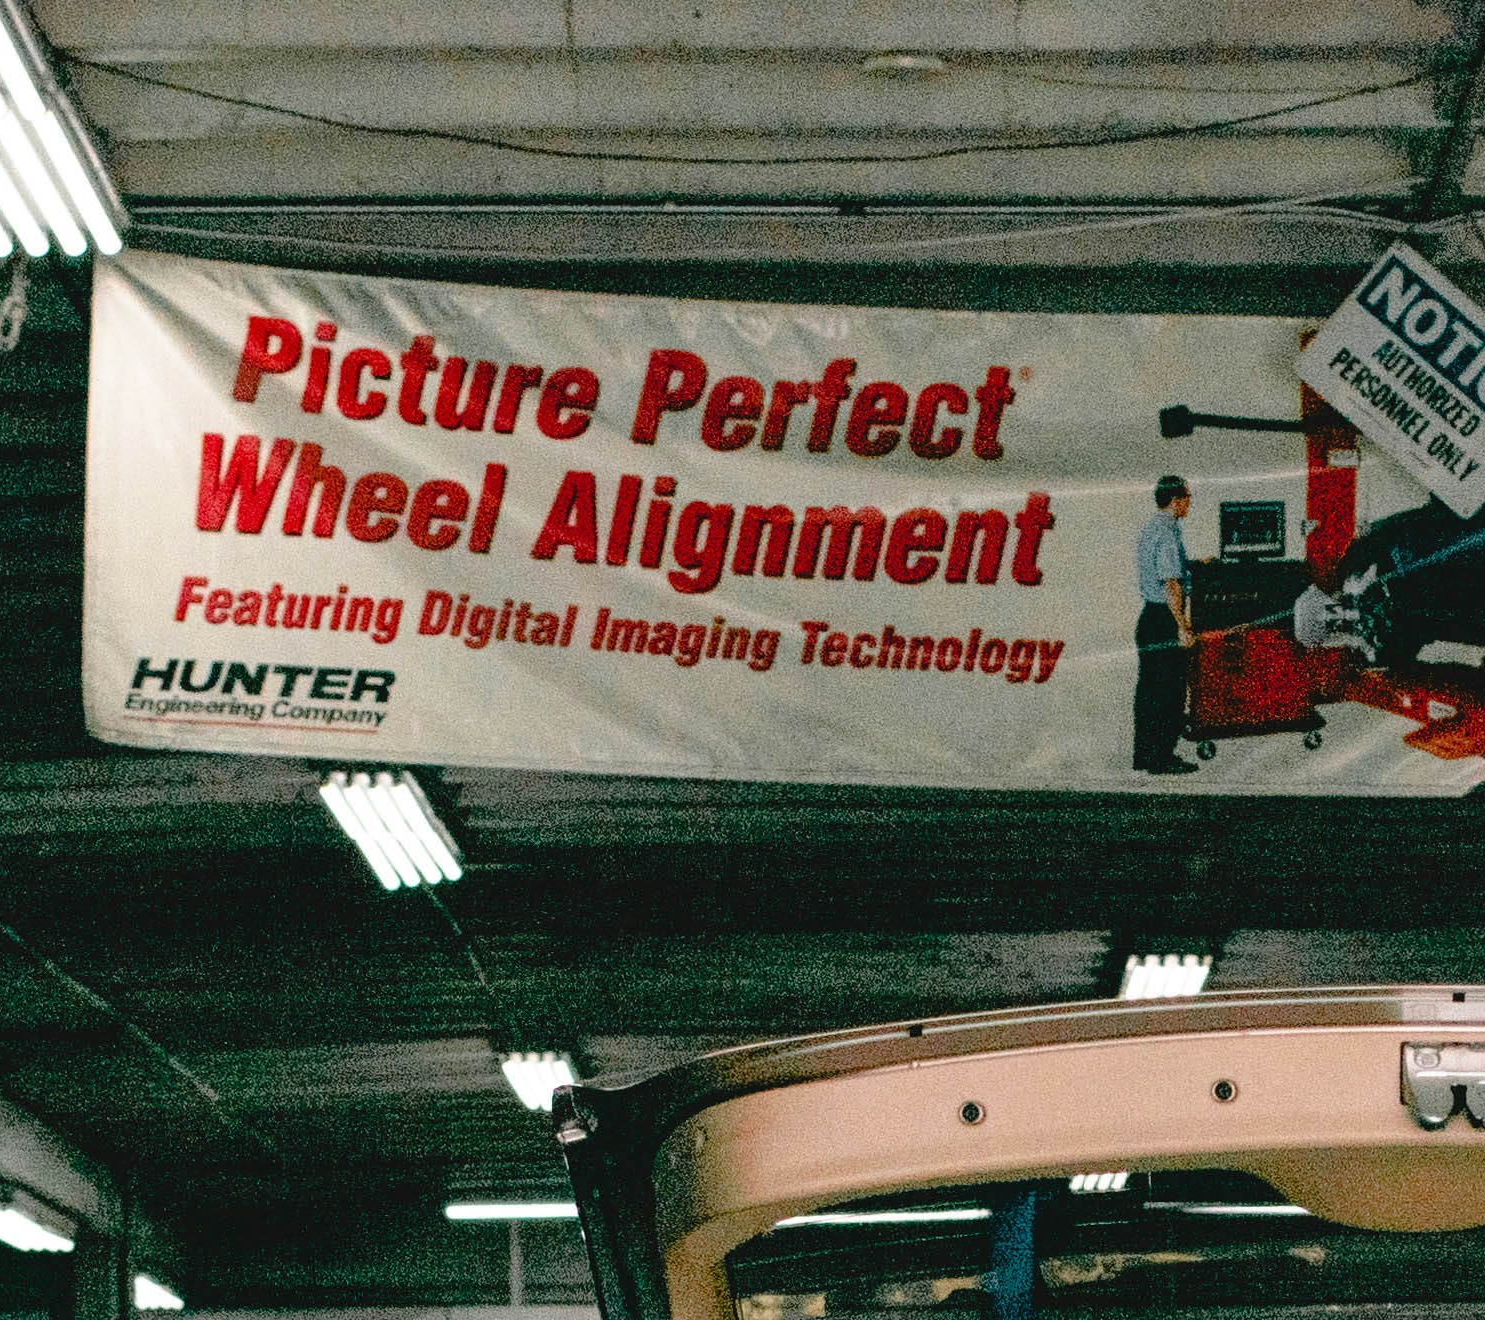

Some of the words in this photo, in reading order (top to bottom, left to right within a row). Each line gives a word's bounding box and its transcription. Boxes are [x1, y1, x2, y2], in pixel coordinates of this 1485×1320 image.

[232, 315, 601, 440] Picture
[630, 348, 1015, 460] Perfect
[1328, 346, 1431, 445] PERSONNEL
[1426, 432, 1481, 482] ONLY
[1372, 339, 1482, 438] AUTHORIZED
[196, 432, 507, 555] Wheel
[531, 470, 1055, 595] Alignment
[131, 656, 397, 704] HUNTER
[174, 575, 404, 645] Featuring
[417, 588, 579, 651] Digital
[590, 605, 780, 672] Imaging
[801, 621, 1065, 685] Technology
[123, 692, 265, 720] Engineering
[271, 699, 388, 727] Company
